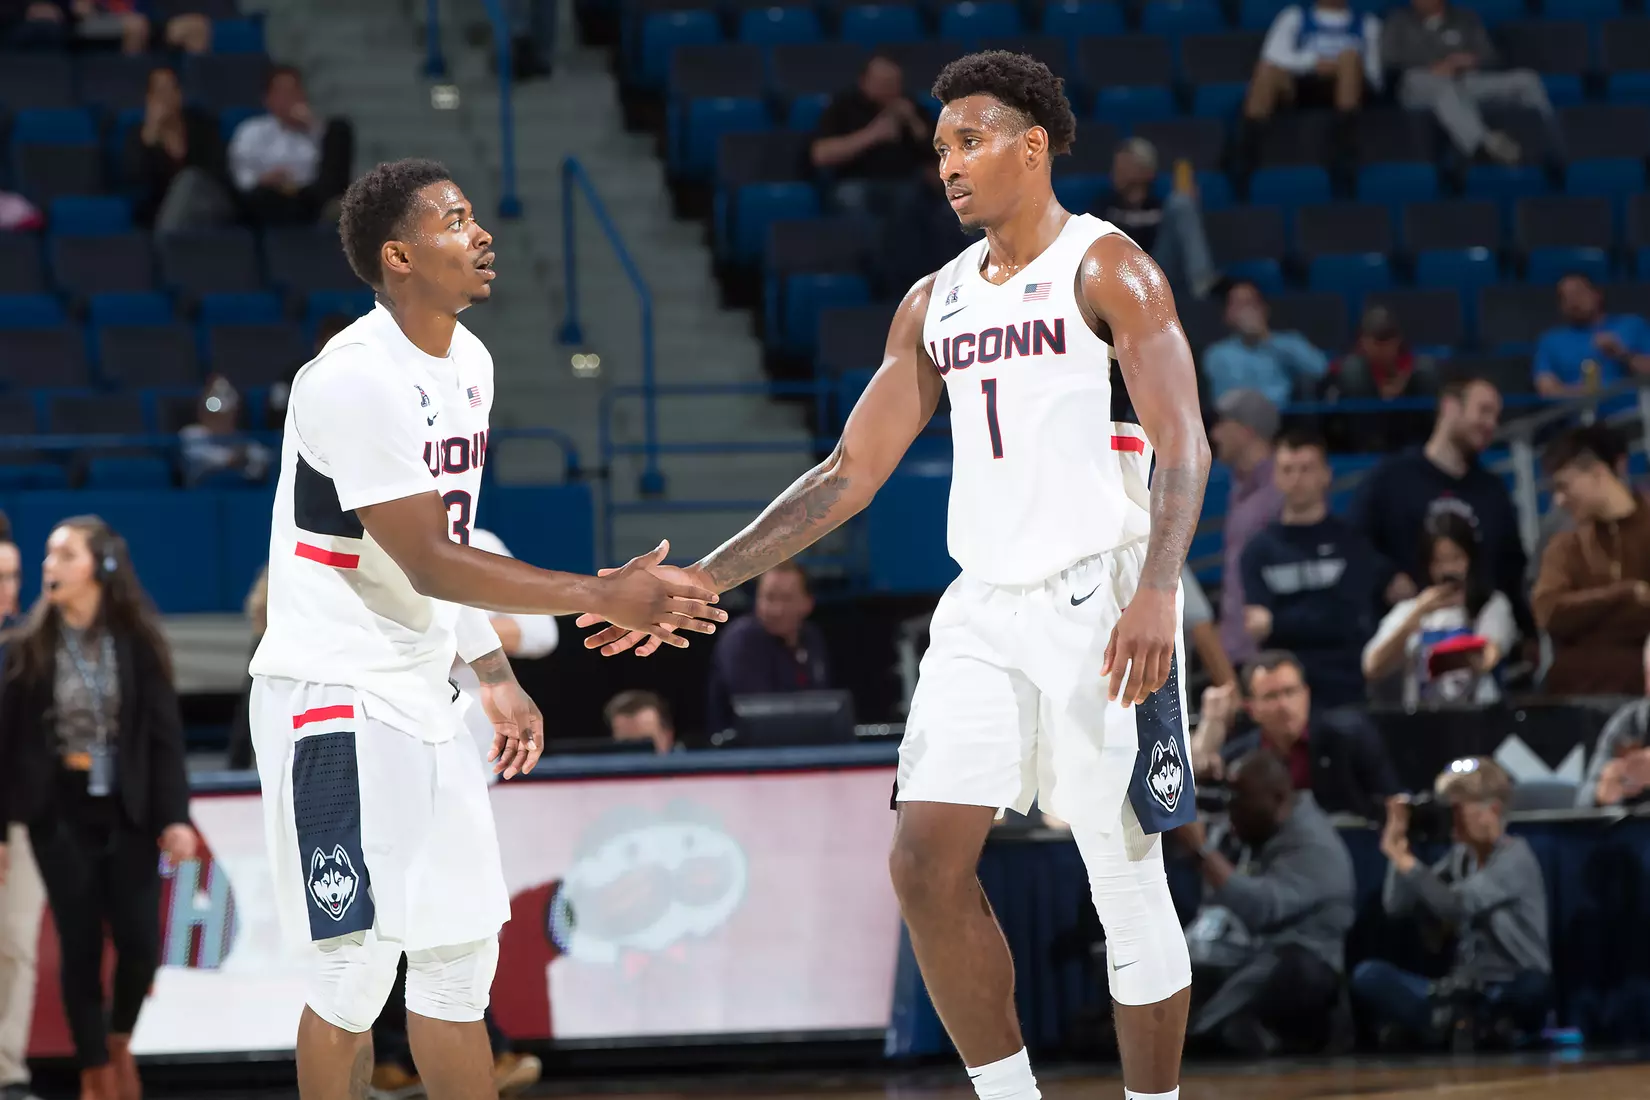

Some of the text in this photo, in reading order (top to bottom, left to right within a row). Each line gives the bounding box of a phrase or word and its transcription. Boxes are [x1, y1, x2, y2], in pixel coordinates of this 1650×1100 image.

[930, 318, 1066, 375] UCONN
[981, 378, 1004, 459] 1
[442, 490, 471, 546] 3
